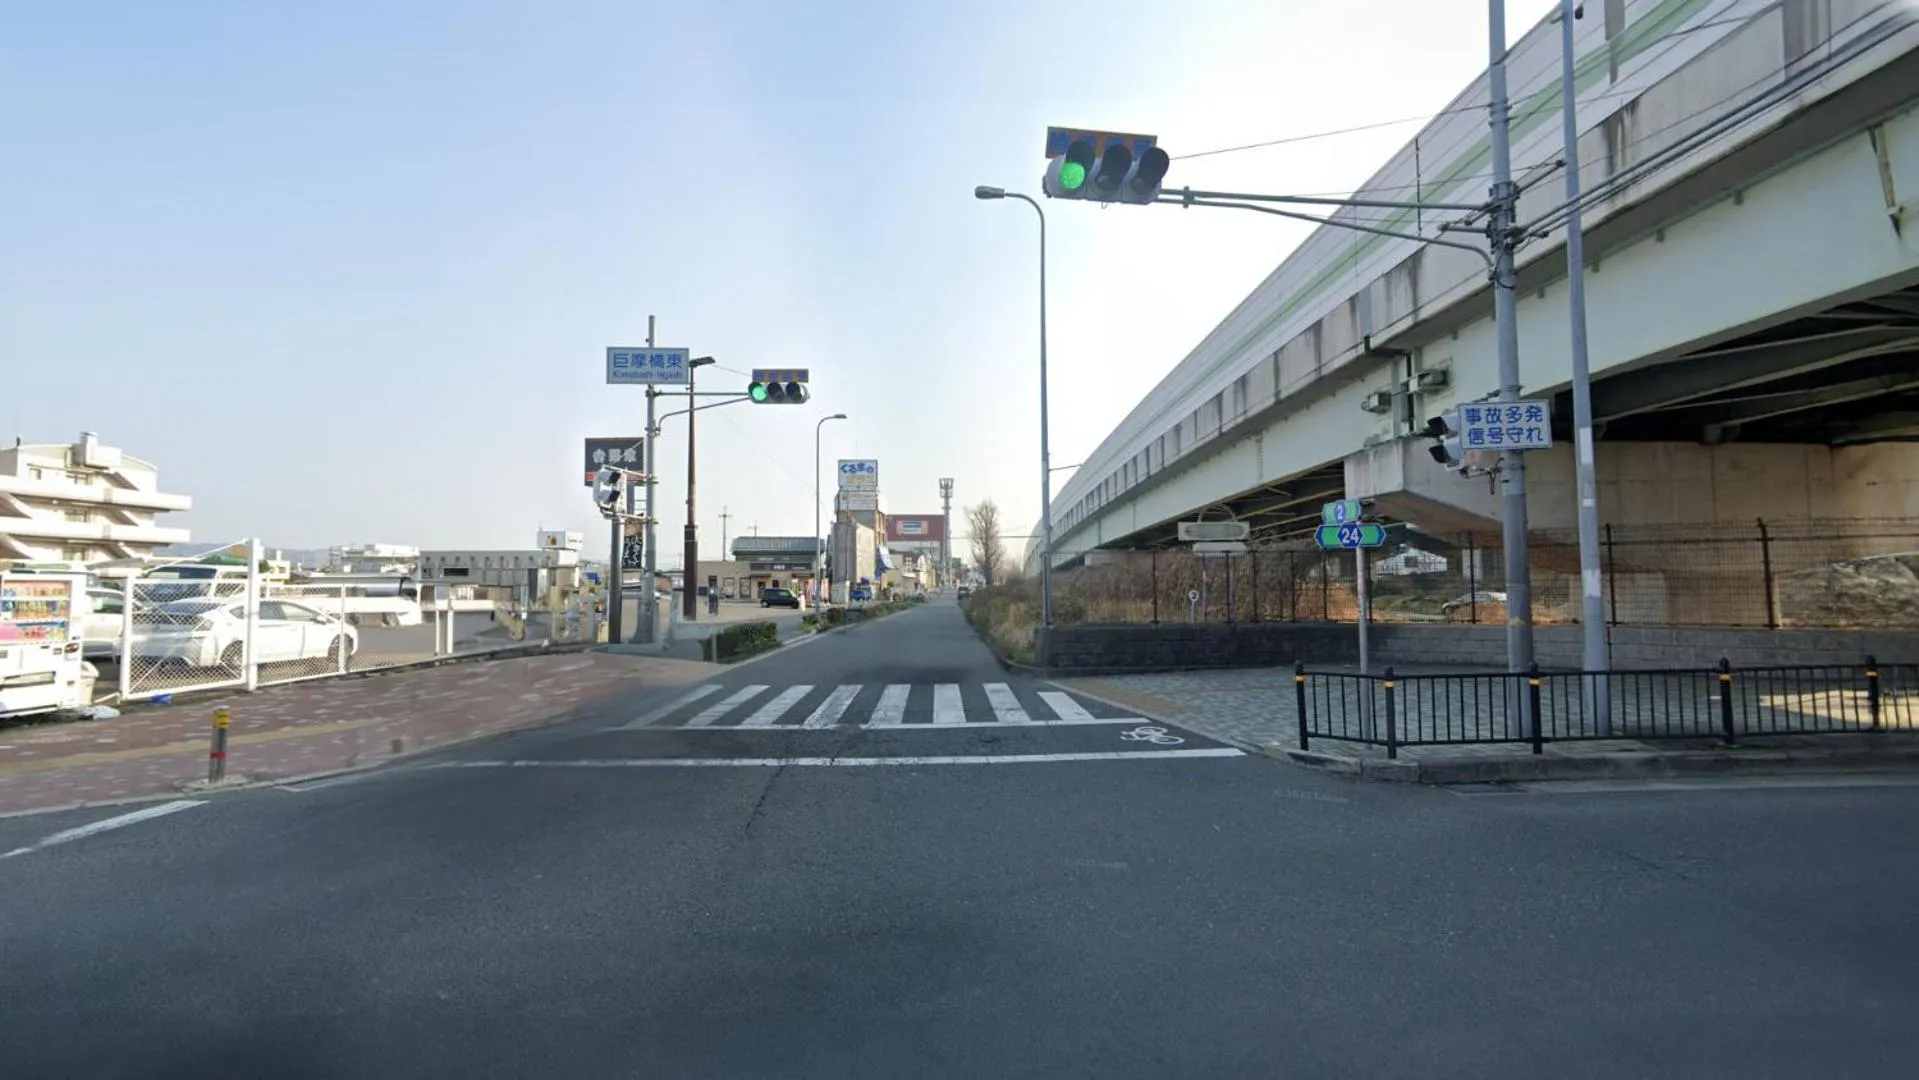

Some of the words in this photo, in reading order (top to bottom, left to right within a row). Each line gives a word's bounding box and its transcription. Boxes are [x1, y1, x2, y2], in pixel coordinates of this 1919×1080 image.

[613, 352, 682, 369] 巨摩橋東
[1464, 405, 1544, 425] 事故多発
[1467, 427, 1544, 445] 信号守れ
[1336, 503, 1343, 520] 2
[1341, 527, 1360, 544] 24
